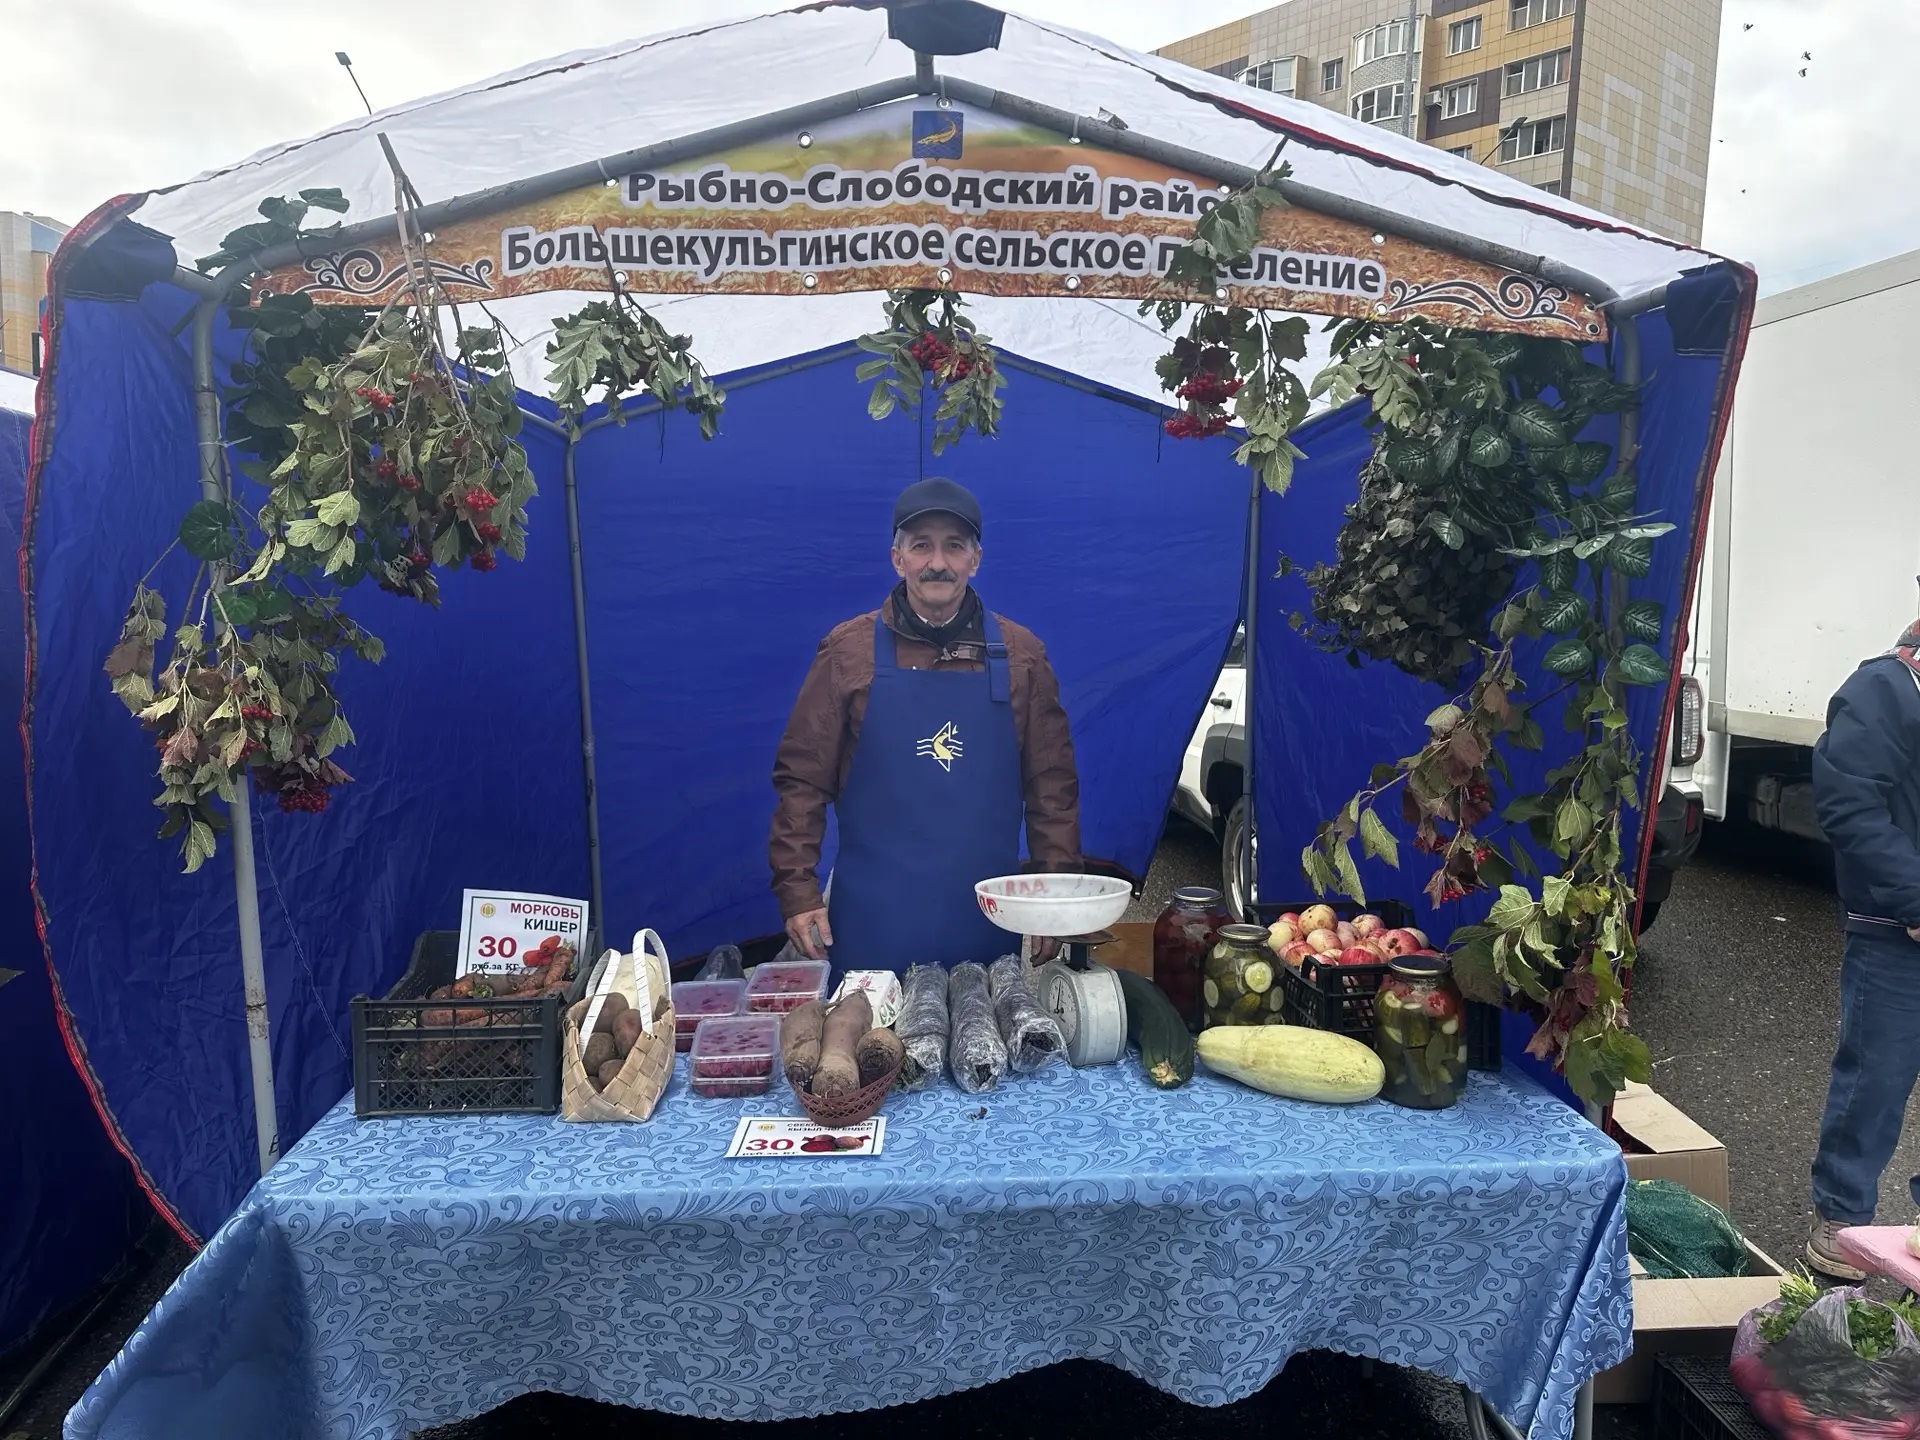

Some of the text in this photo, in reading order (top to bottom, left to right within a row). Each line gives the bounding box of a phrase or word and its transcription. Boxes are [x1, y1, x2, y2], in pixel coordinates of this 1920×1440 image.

[628, 165, 1222, 215] Рыбно-Слободский райо
[508, 228, 1381, 293] Большекульгинское сельское пеление
[510, 902, 580, 919] МОРКОВЬ
[524, 918, 578, 933] КИШЕР
[478, 936, 517, 958] 30
[745, 1138, 794, 1151] 30
